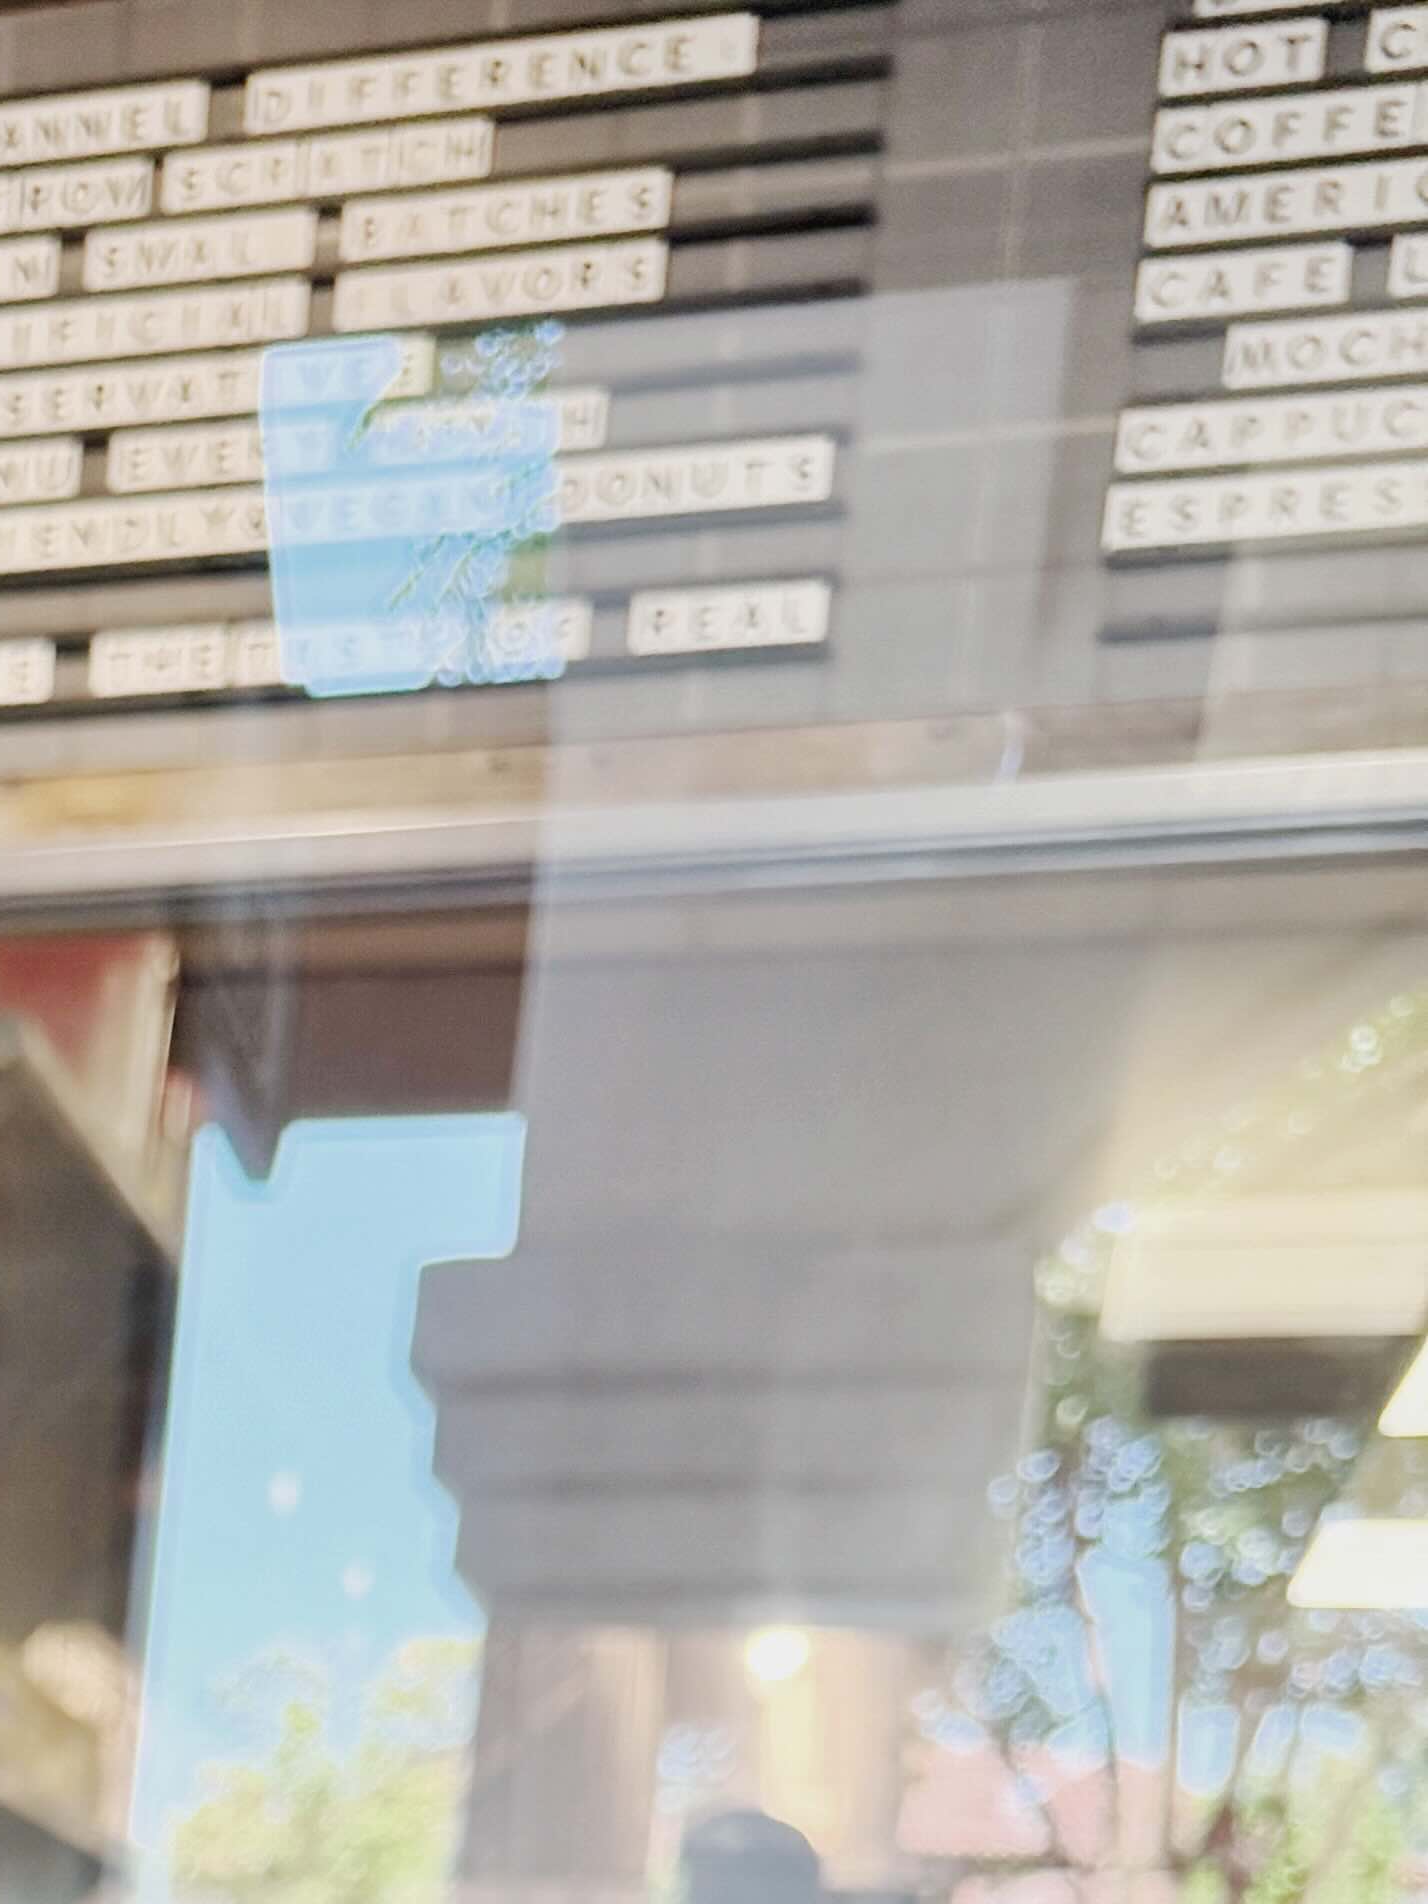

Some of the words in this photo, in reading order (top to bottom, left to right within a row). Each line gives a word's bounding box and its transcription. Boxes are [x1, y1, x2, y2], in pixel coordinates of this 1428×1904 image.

[1169, 30, 1315, 84] HOT
[1148, 254, 1339, 310] CAFE
[556, 452, 820, 508] DONUTS
